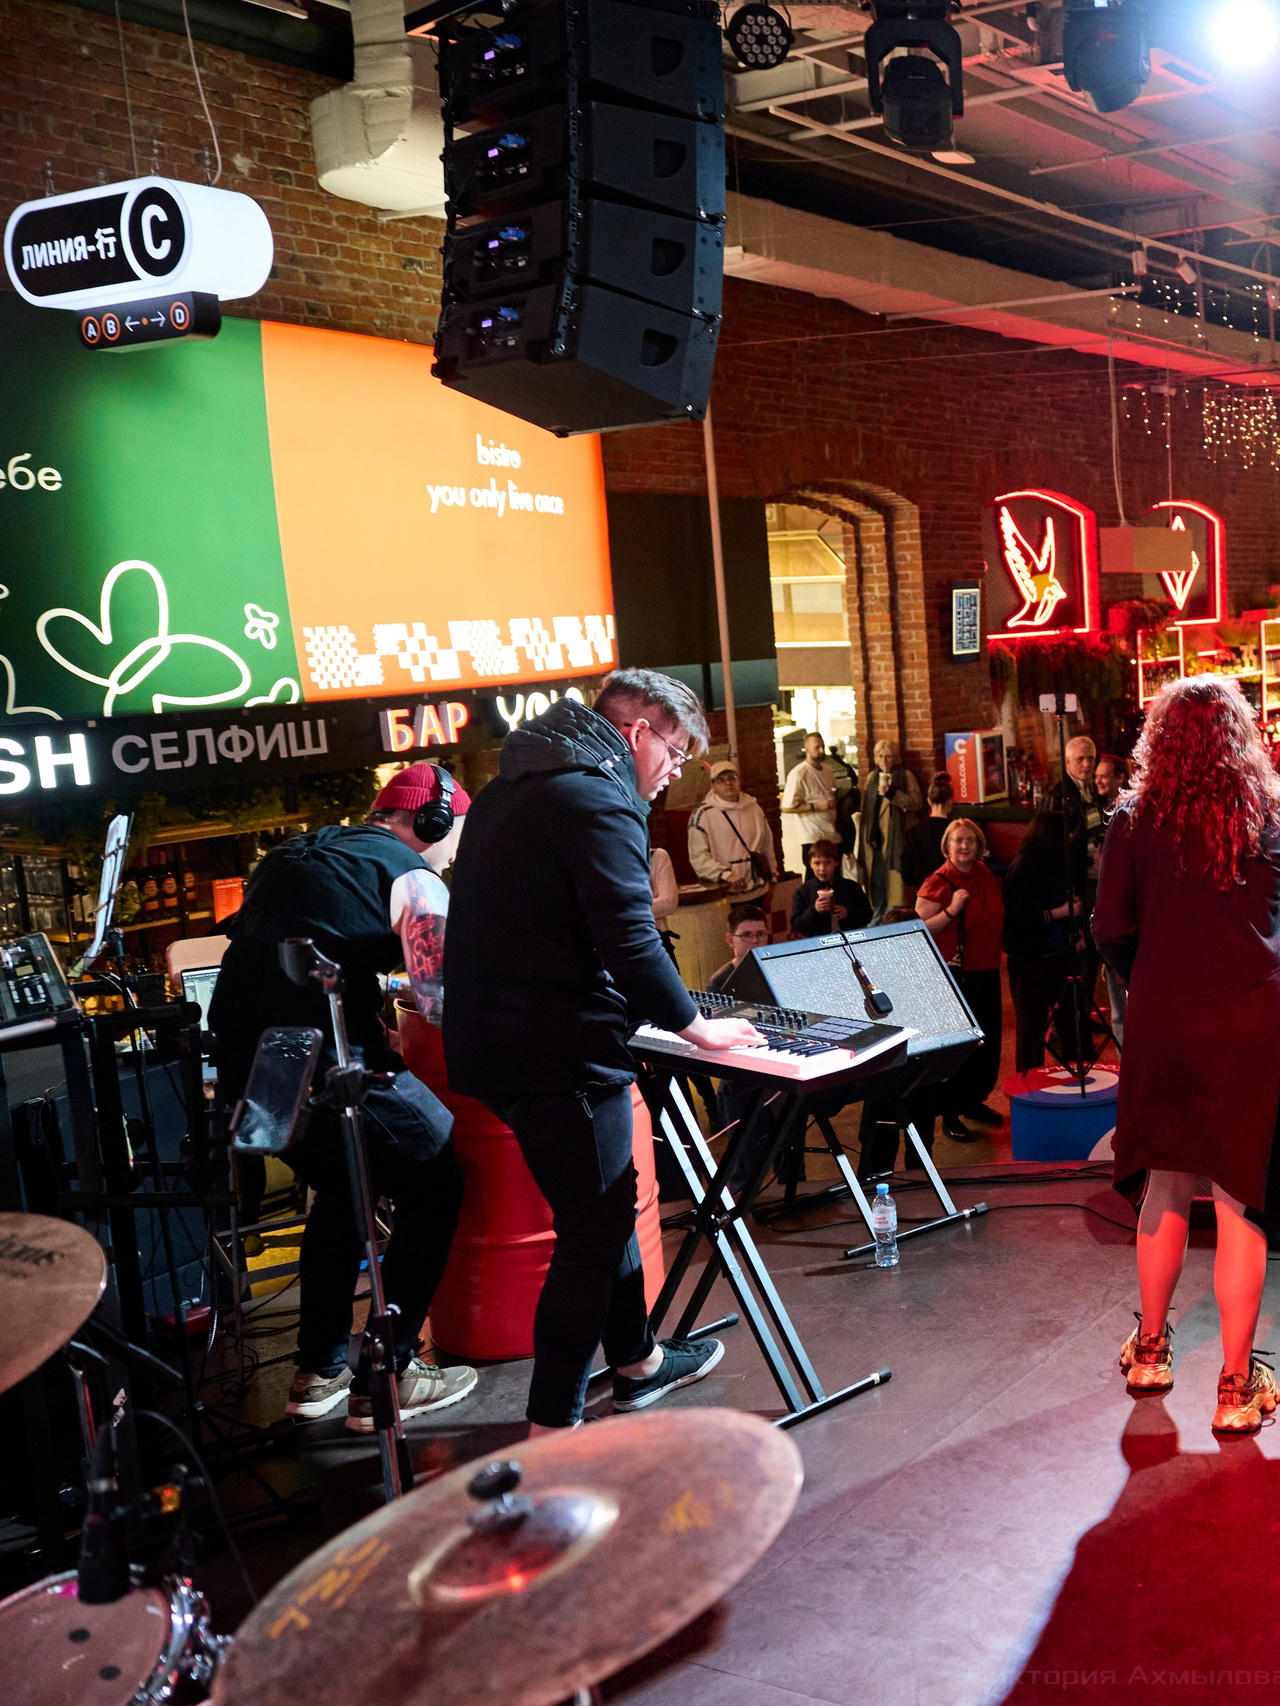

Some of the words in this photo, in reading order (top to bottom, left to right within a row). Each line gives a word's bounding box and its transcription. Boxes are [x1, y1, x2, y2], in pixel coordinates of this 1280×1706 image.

[21, 227, 117, 271] ЛИНИЯ-行
[87, 322, 97, 338] A
[105, 319, 116, 335] B
[175, 309, 185, 324] D
[0, 452, 63, 491] бе
[476, 433, 522, 469] bistro
[426, 484, 466, 514] you
[469, 477, 507, 518] only
[507, 479, 534, 512] live
[385, 702, 469, 752] БАР
[496, 687, 585, 731] YO
[112, 719, 328, 774] СЕЛФИШ
